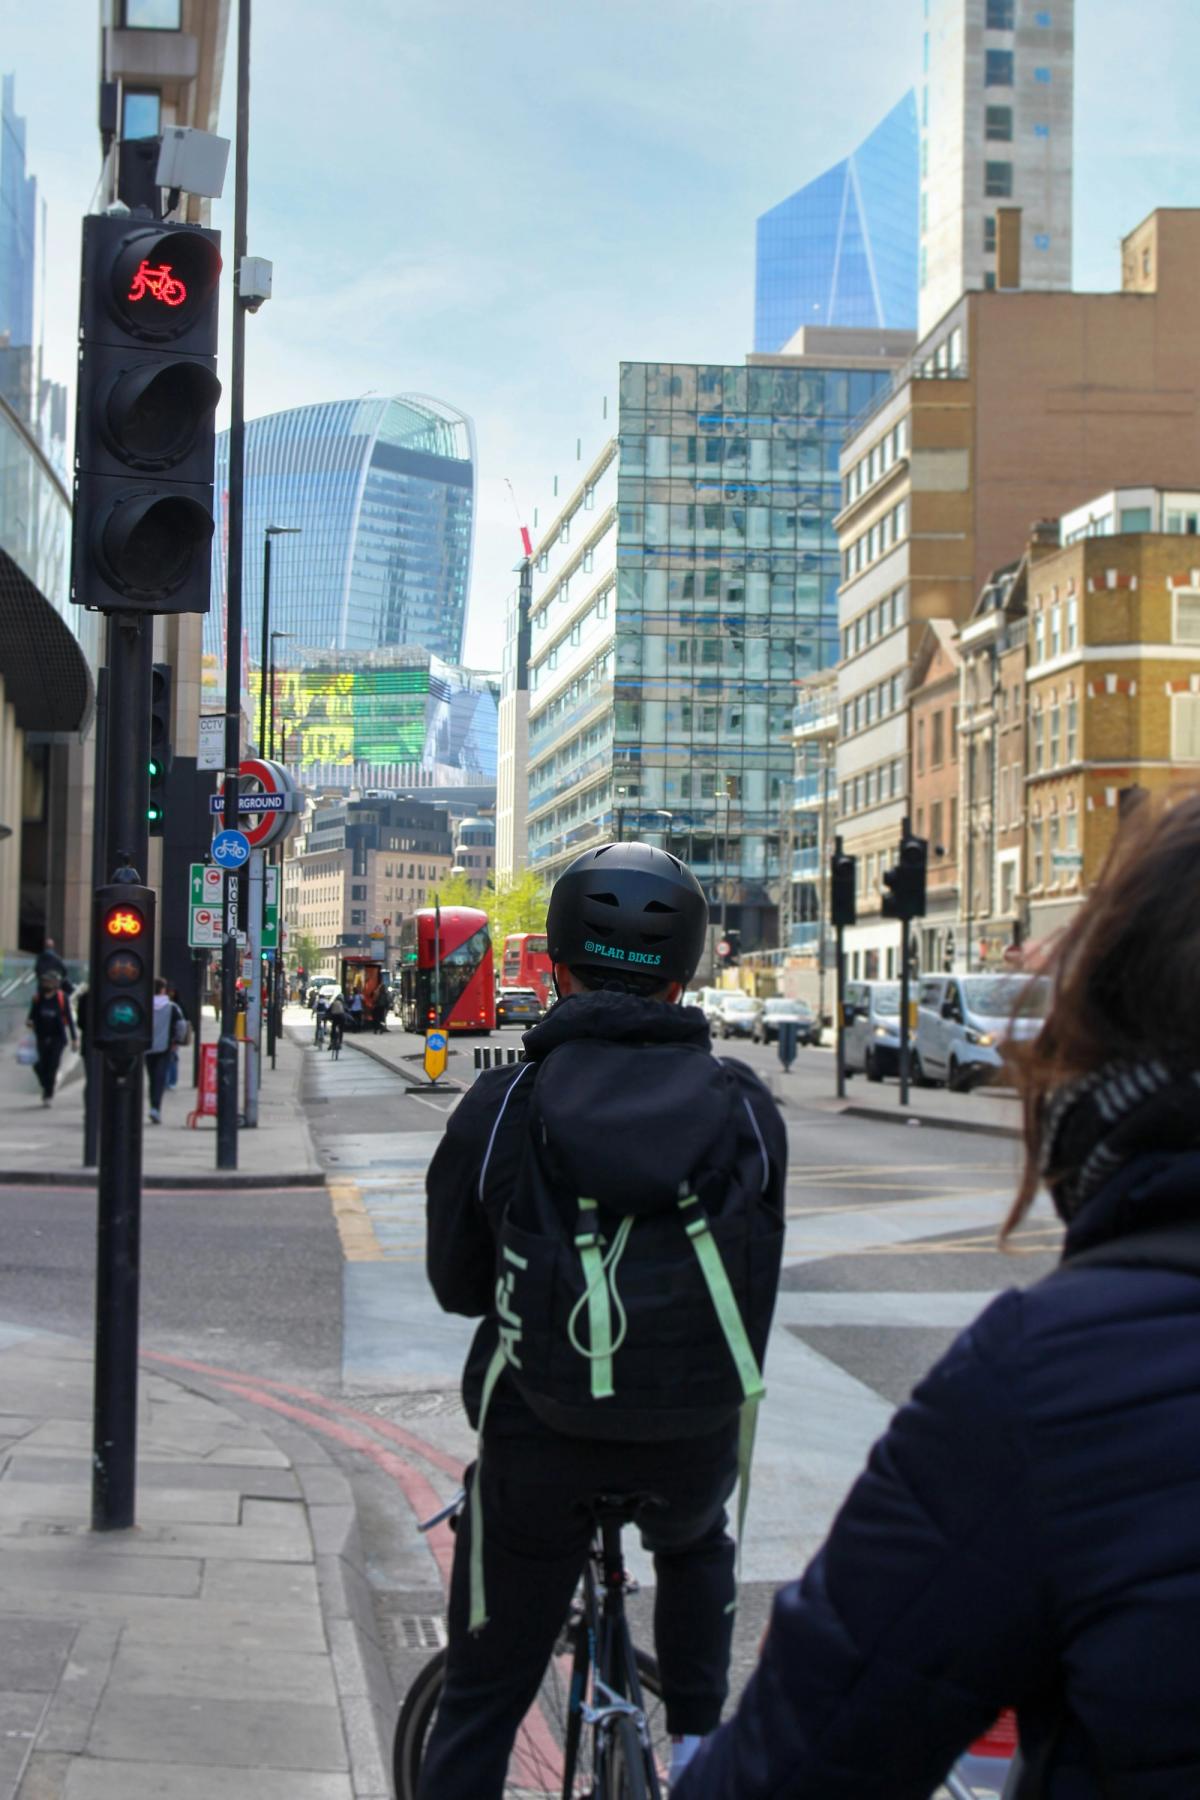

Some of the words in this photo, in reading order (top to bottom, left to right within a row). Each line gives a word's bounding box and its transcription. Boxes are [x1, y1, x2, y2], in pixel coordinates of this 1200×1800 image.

[200, 720, 223, 730] CCTV
[214, 797, 282, 810] URGROUND
[627, 951, 662, 966] BIKES
